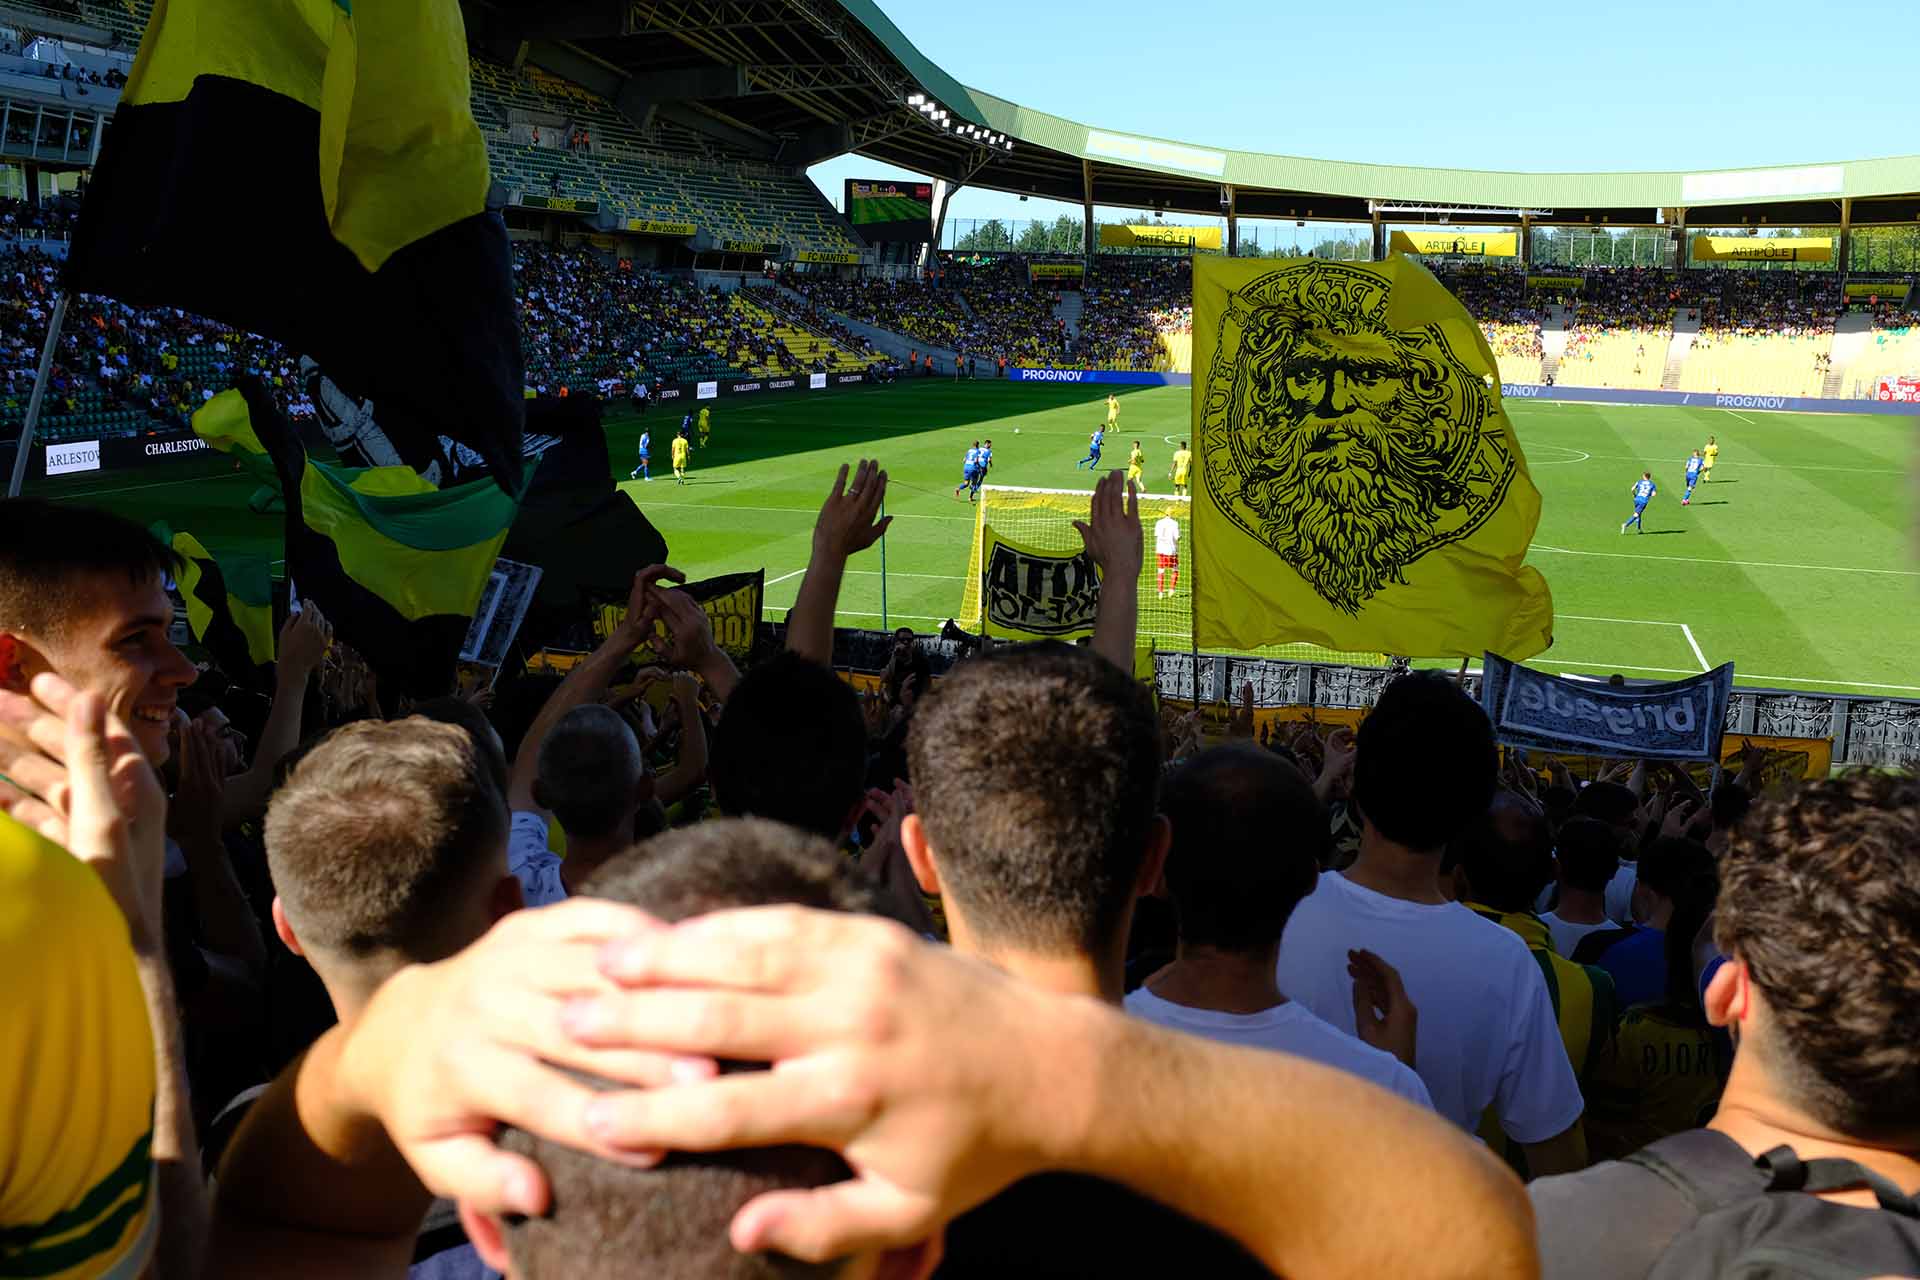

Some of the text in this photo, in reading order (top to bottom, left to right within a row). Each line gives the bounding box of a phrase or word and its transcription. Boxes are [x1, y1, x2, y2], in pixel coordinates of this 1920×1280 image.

[650, 223, 663, 231] new
[663, 223, 688, 233] balance
[1731, 241, 1789, 257] ARTIPÔLE
[807, 253, 849, 263] FC NANTES
[1022, 369, 1083, 382] PROG/NOV
[1501, 385, 1539, 398] G/NOV
[1715, 395, 1785, 409] PROG/NOV
